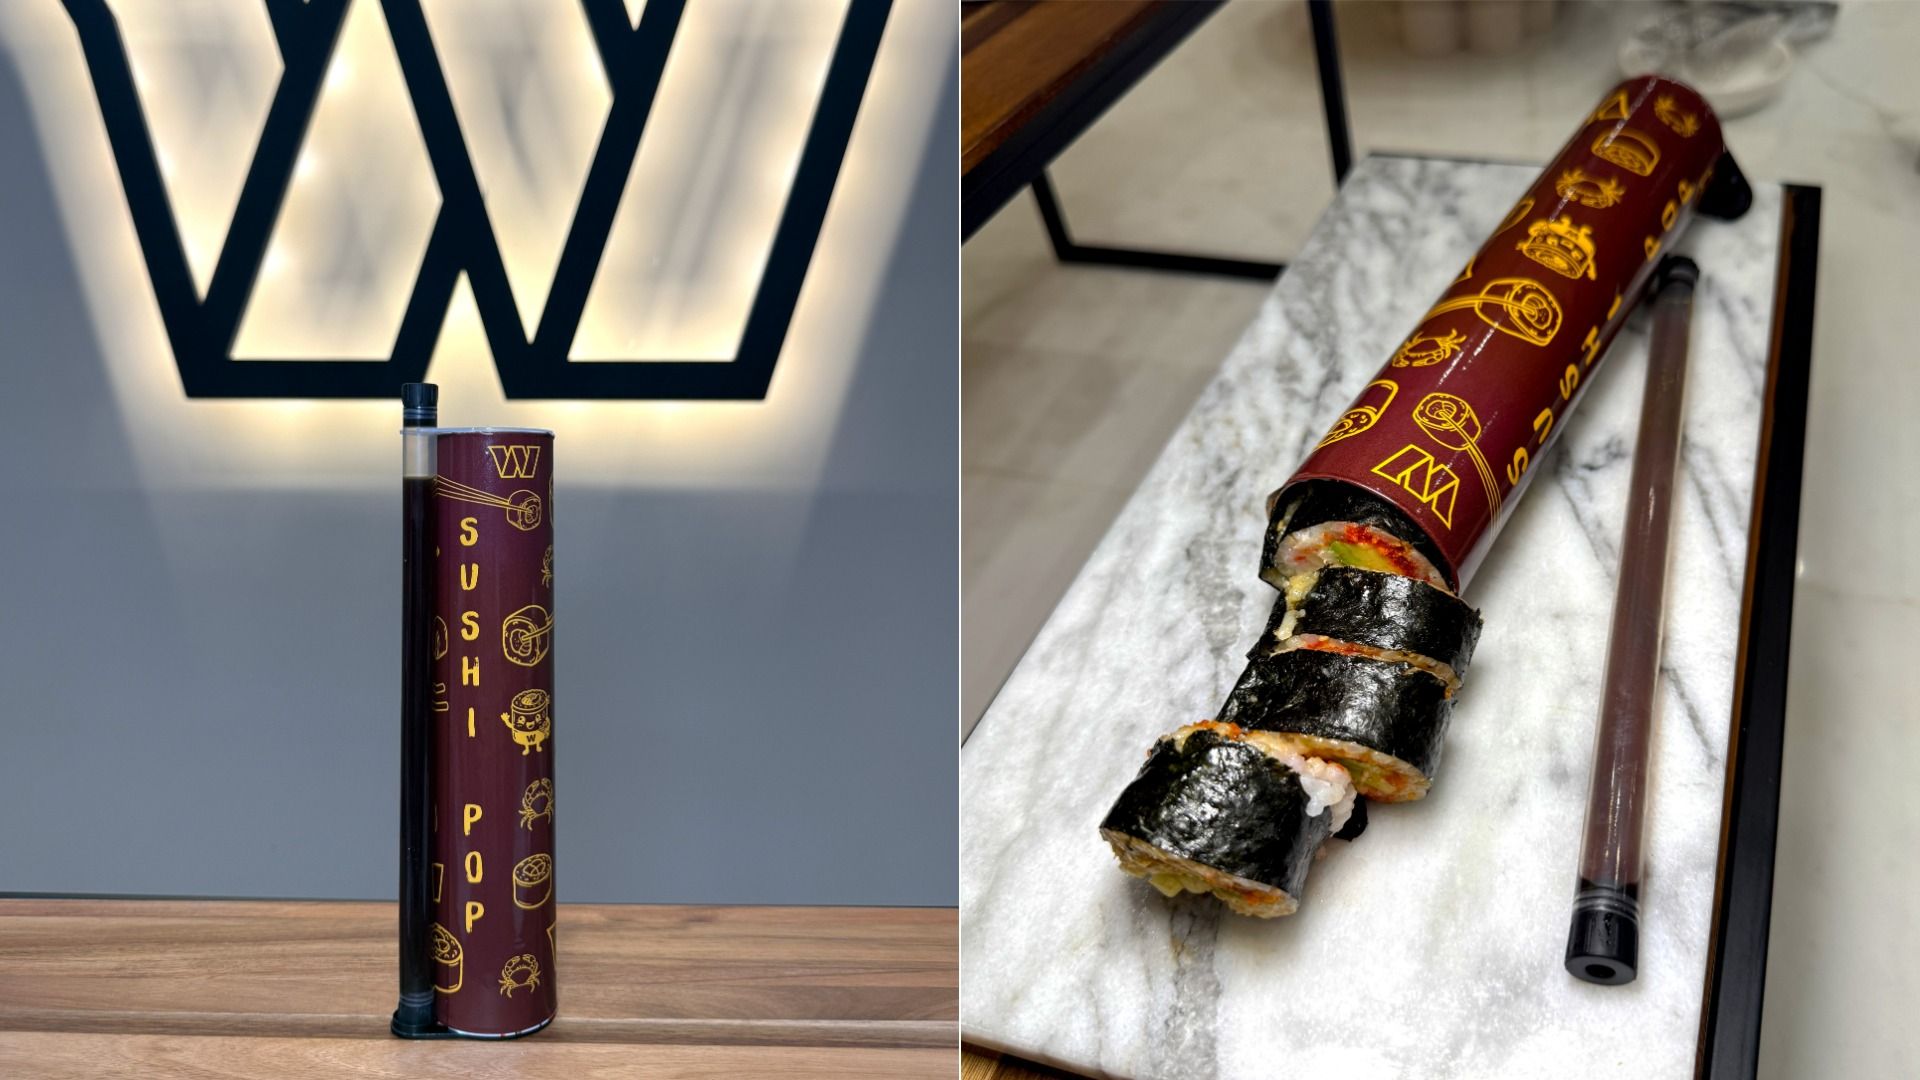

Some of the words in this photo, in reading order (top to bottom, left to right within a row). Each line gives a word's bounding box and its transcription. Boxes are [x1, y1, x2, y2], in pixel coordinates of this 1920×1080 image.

[1506, 294, 1622, 486] SUSHI
[488, 446, 541, 478] W
[459, 516, 480, 738] SUSHI
[526, 733, 536, 743] W
[463, 803, 485, 934] POP
